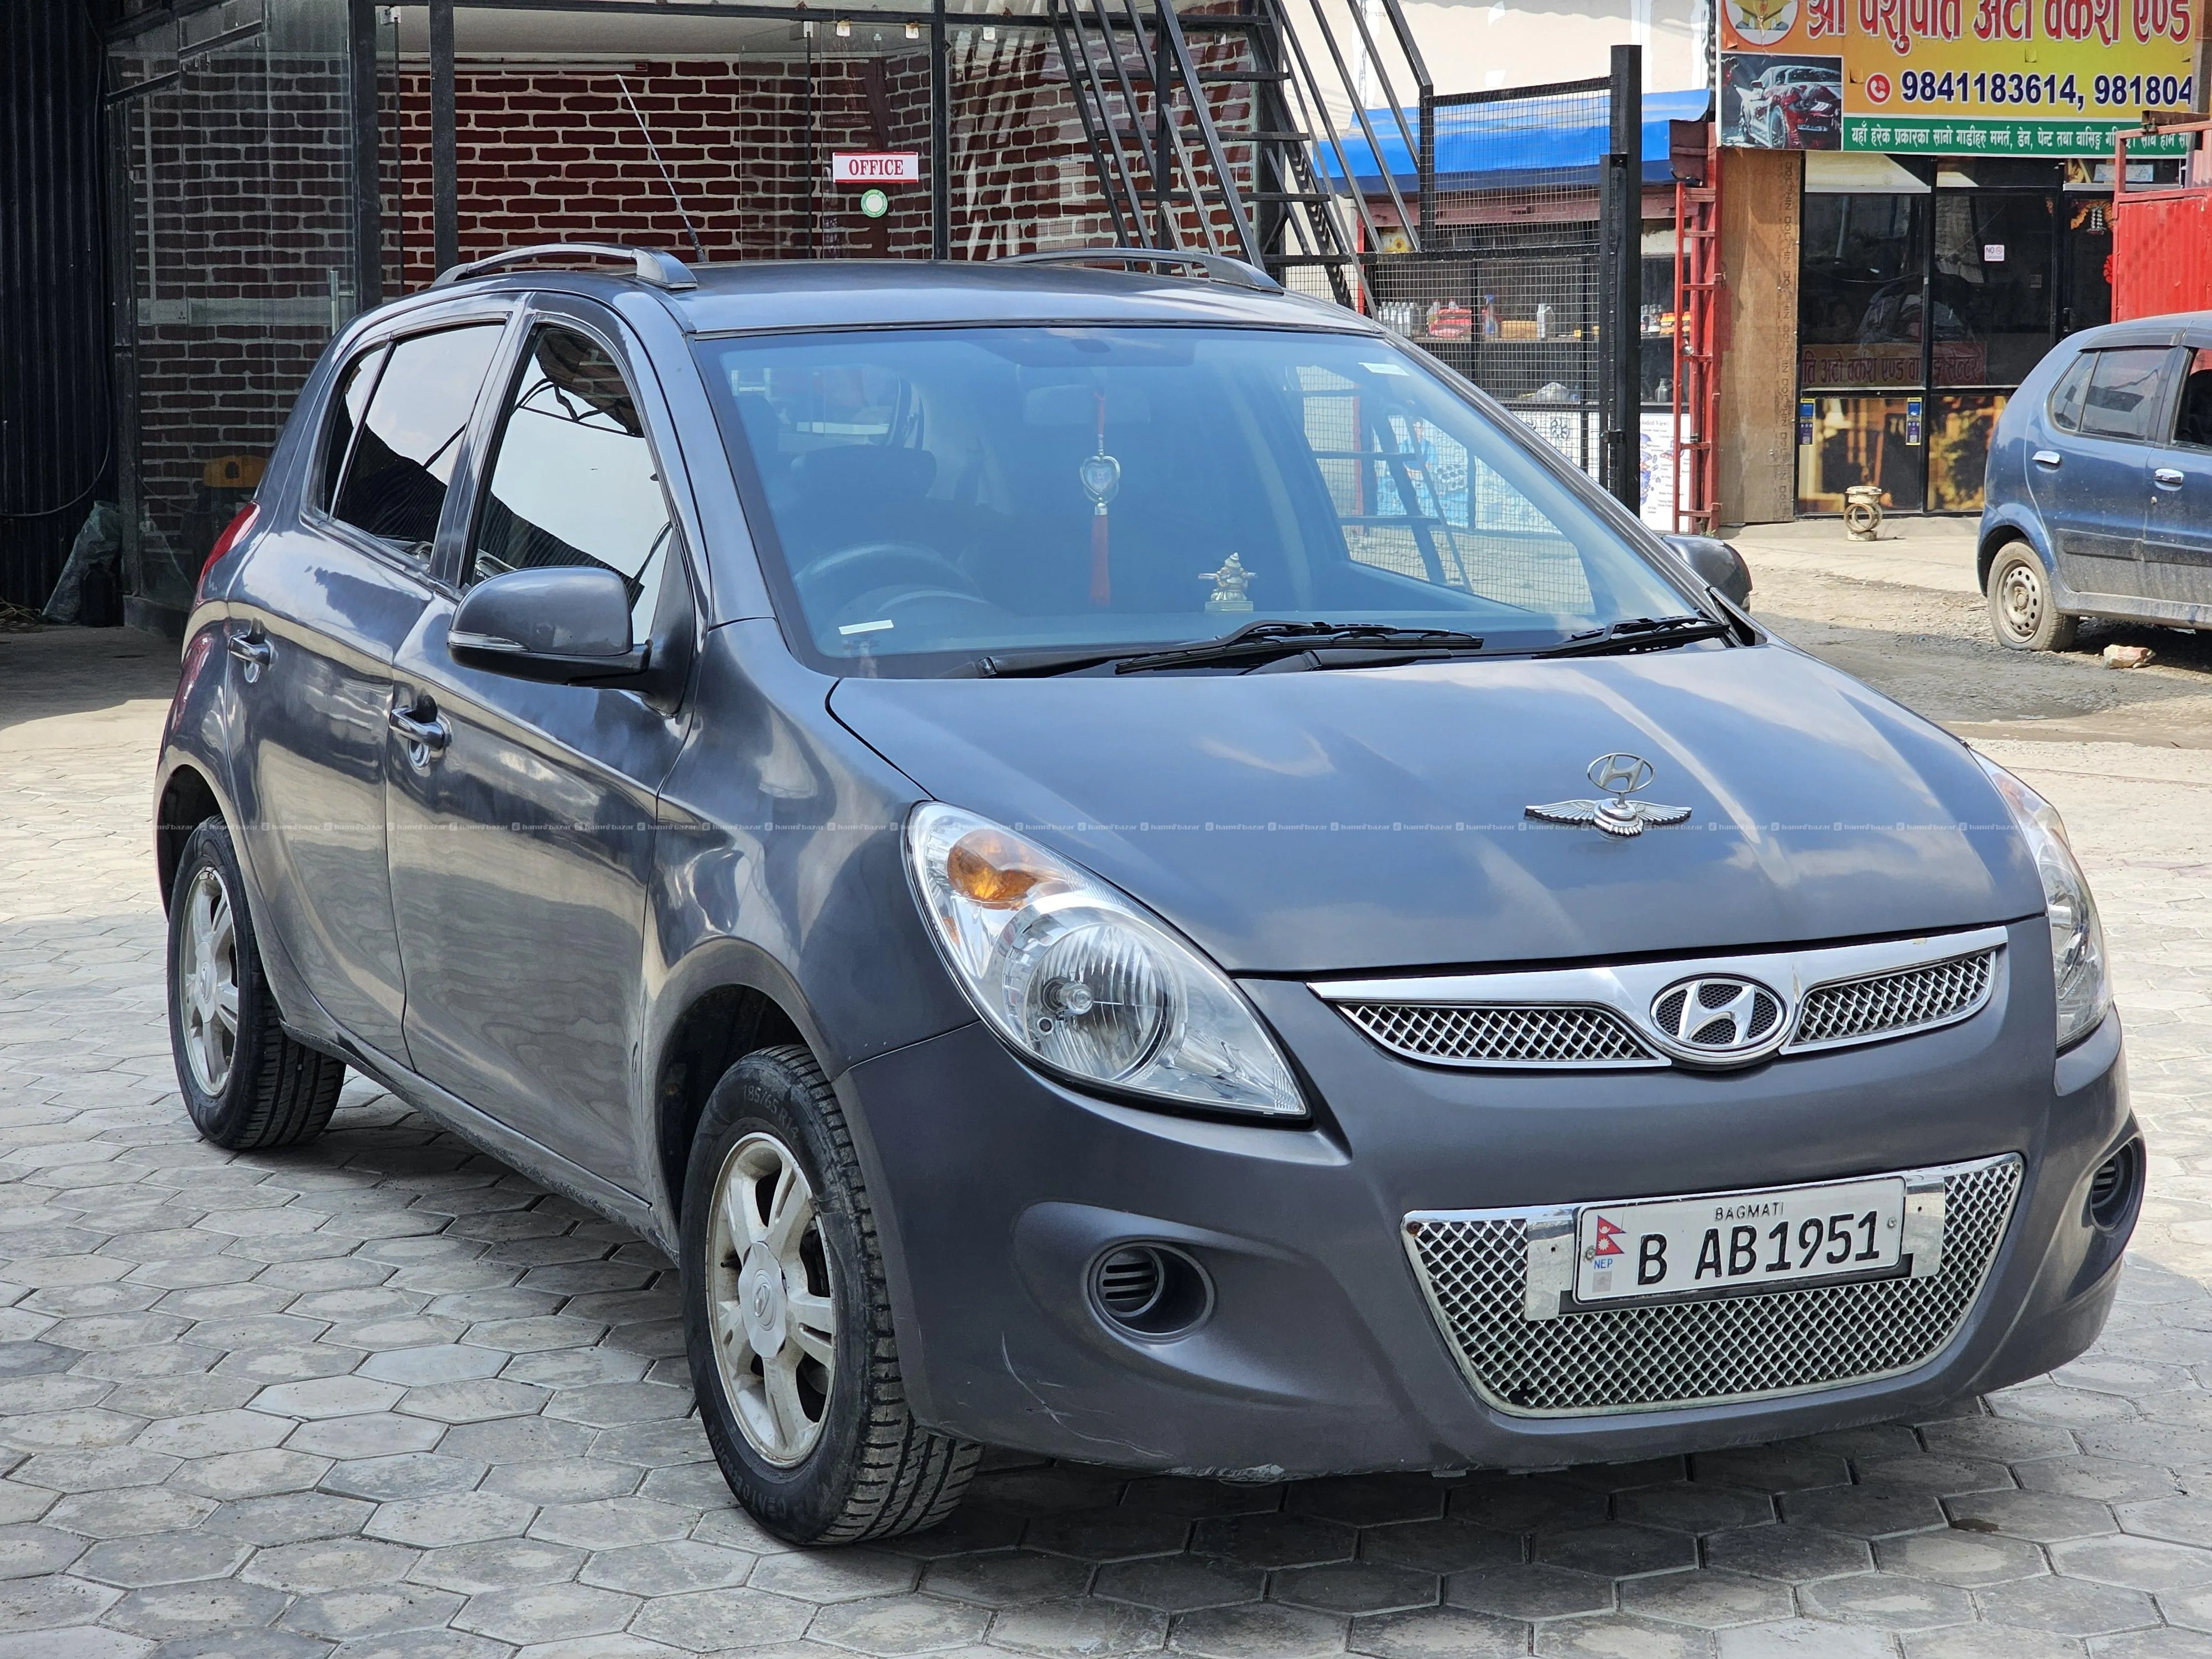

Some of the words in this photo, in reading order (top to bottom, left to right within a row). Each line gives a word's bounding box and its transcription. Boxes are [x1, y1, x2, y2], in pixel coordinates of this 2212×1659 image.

[1901, 71, 2084, 111] 9841183614,
[849, 159, 904, 175] OFFICE
[1715, 1202, 1784, 1221] BAGMATI
[1594, 1258, 1613, 1270] NEP
[1638, 1234, 1667, 1286] B
